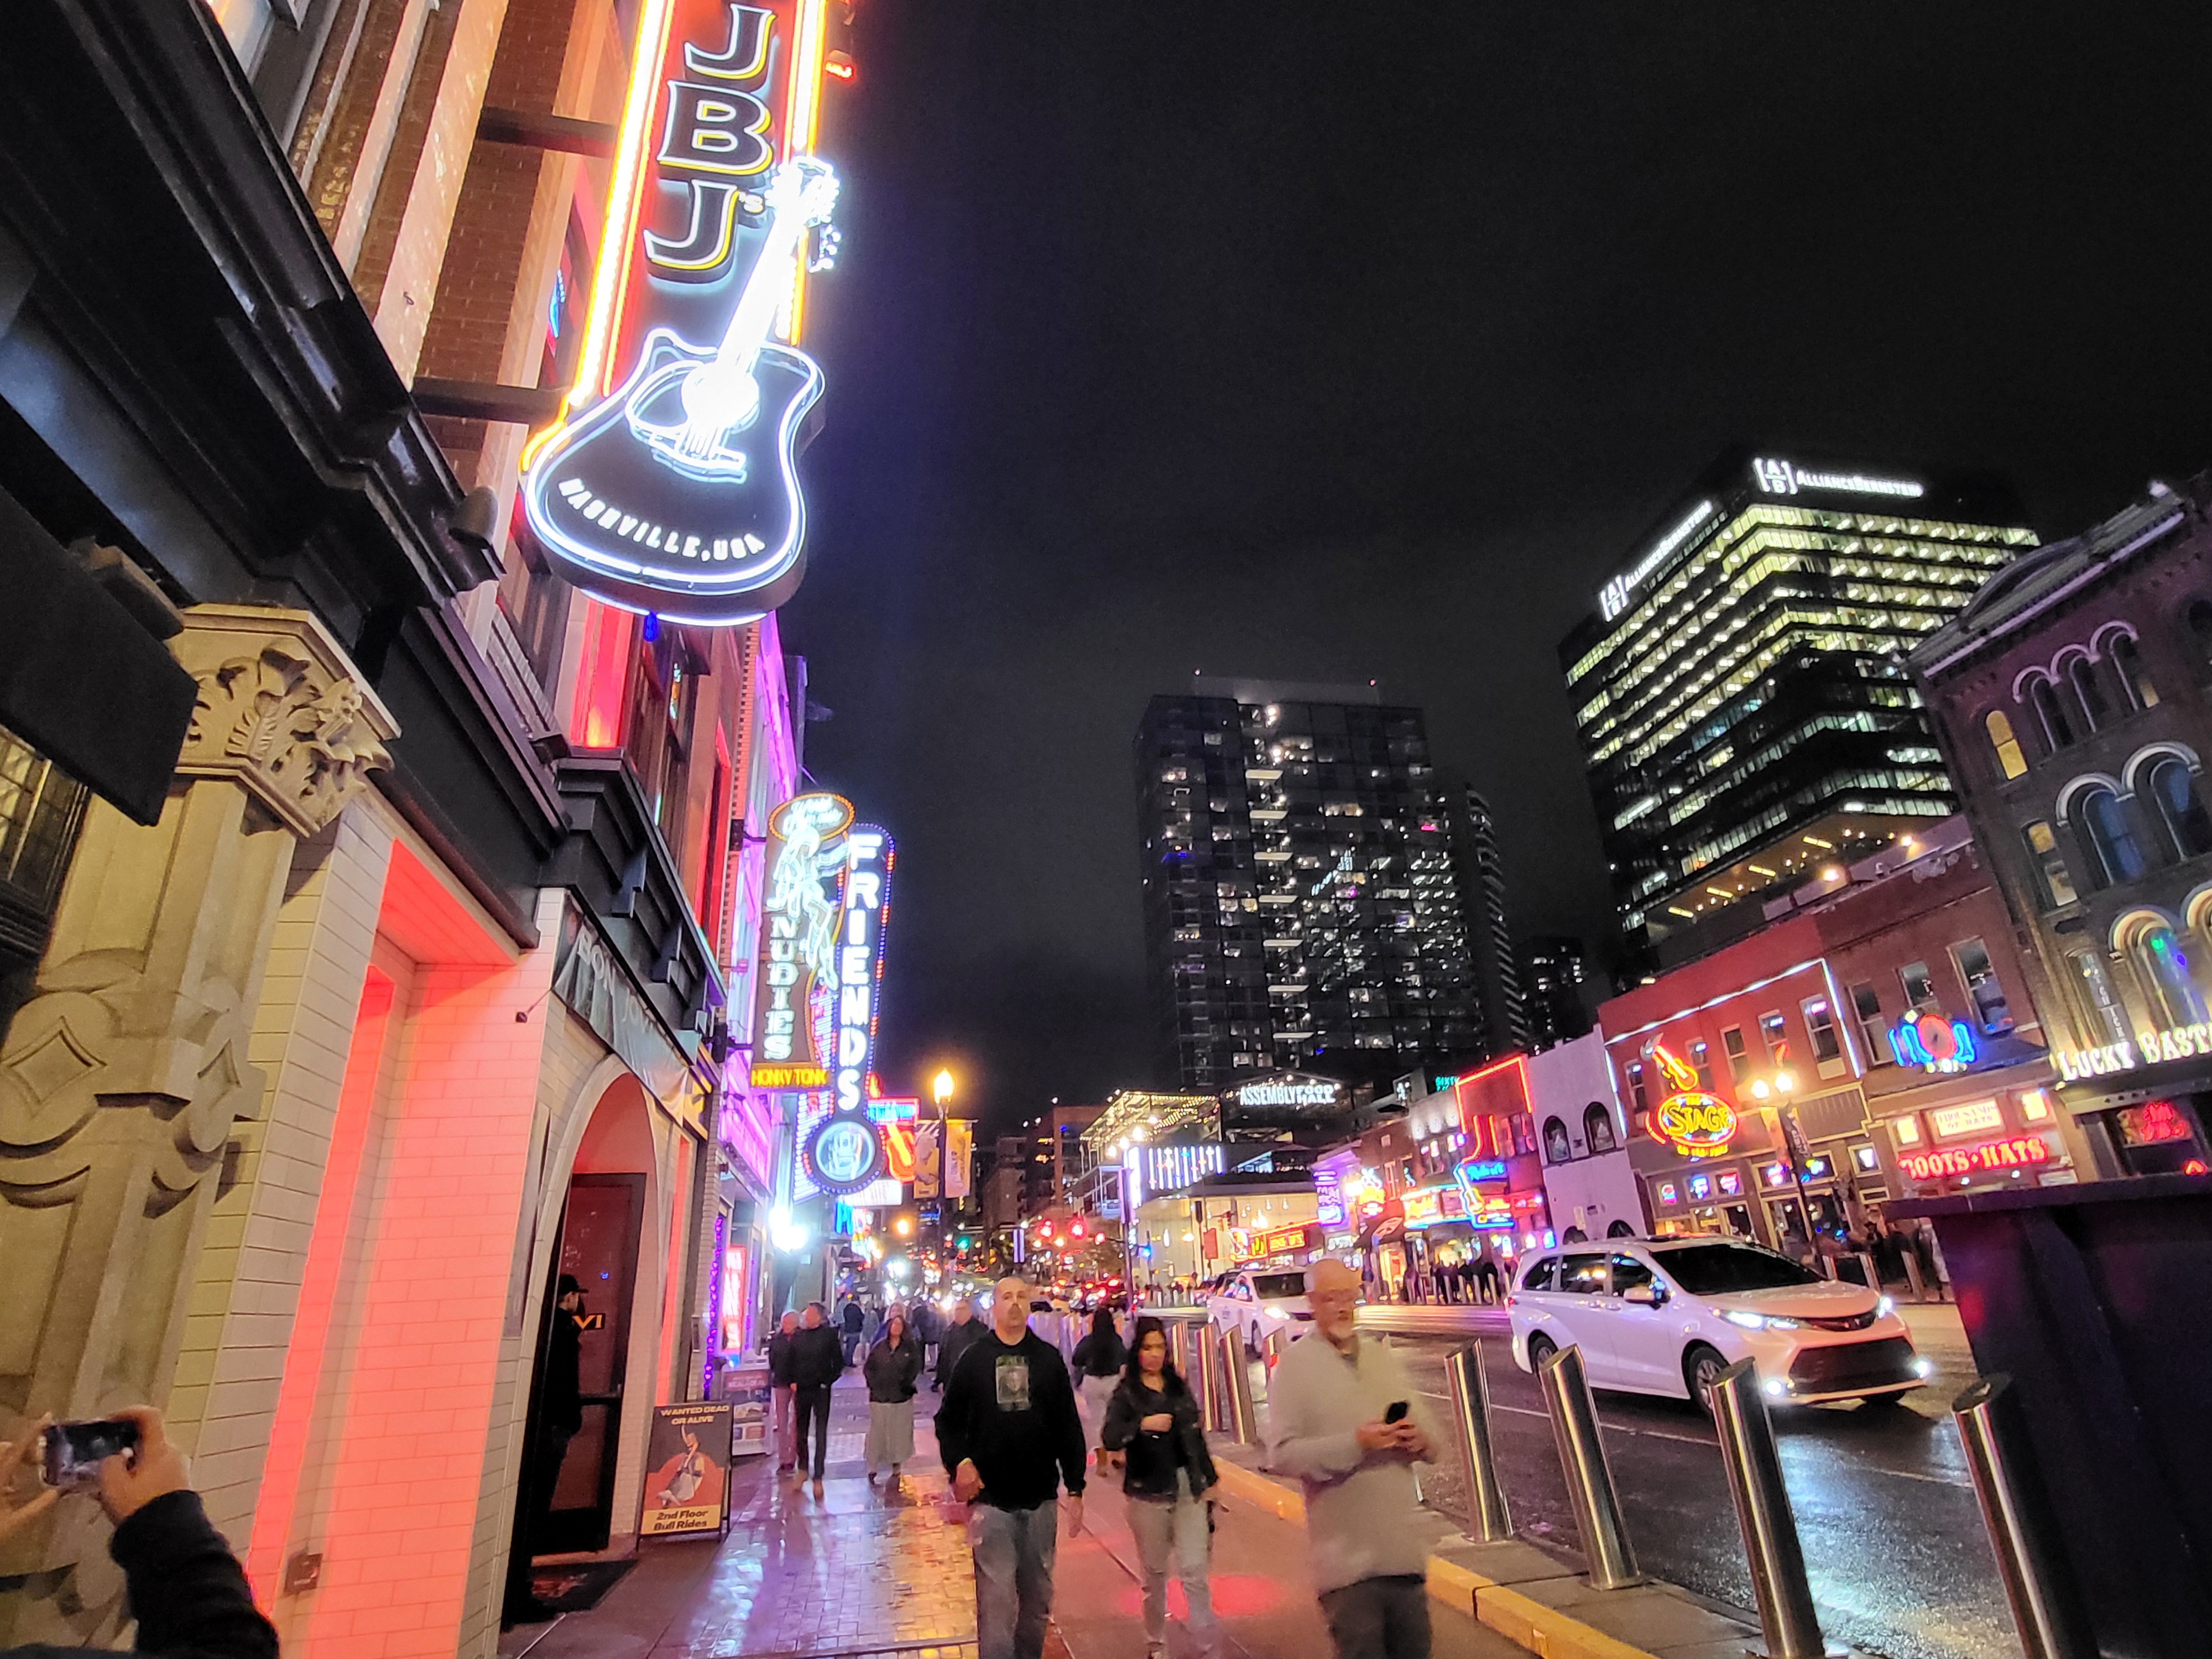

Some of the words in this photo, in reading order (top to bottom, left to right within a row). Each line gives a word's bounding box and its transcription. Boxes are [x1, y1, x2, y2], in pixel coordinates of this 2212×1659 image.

[837, 833, 883, 1112] FRIENDS
[2057, 1041, 2135, 1081] LUCKY
[2137, 1022, 2212, 1065] BAST
[751, 1068, 793, 1086] HONKY
[793, 1068, 828, 1086] TONK
[1239, 1086, 1297, 1106] ASSEMBLY
[1296, 1084, 1334, 1094] FOOD
[1296, 1094, 1337, 1105] HALL
[1664, 1101, 1729, 1137] STAGE
[1965, 1115, 1993, 1126] HATS
[1978, 1136, 2046, 1168] HATS
[660, 1407, 703, 1417] WANTED
[703, 1405, 729, 1413] DEAD
[671, 1417, 686, 1426] OR
[686, 1415, 714, 1425] ALIVE
[656, 1511, 678, 1520] 2nd
[679, 1509, 709, 1519] Floor
[653, 1521, 675, 1531] Bull
[676, 1520, 707, 1530] Rides
